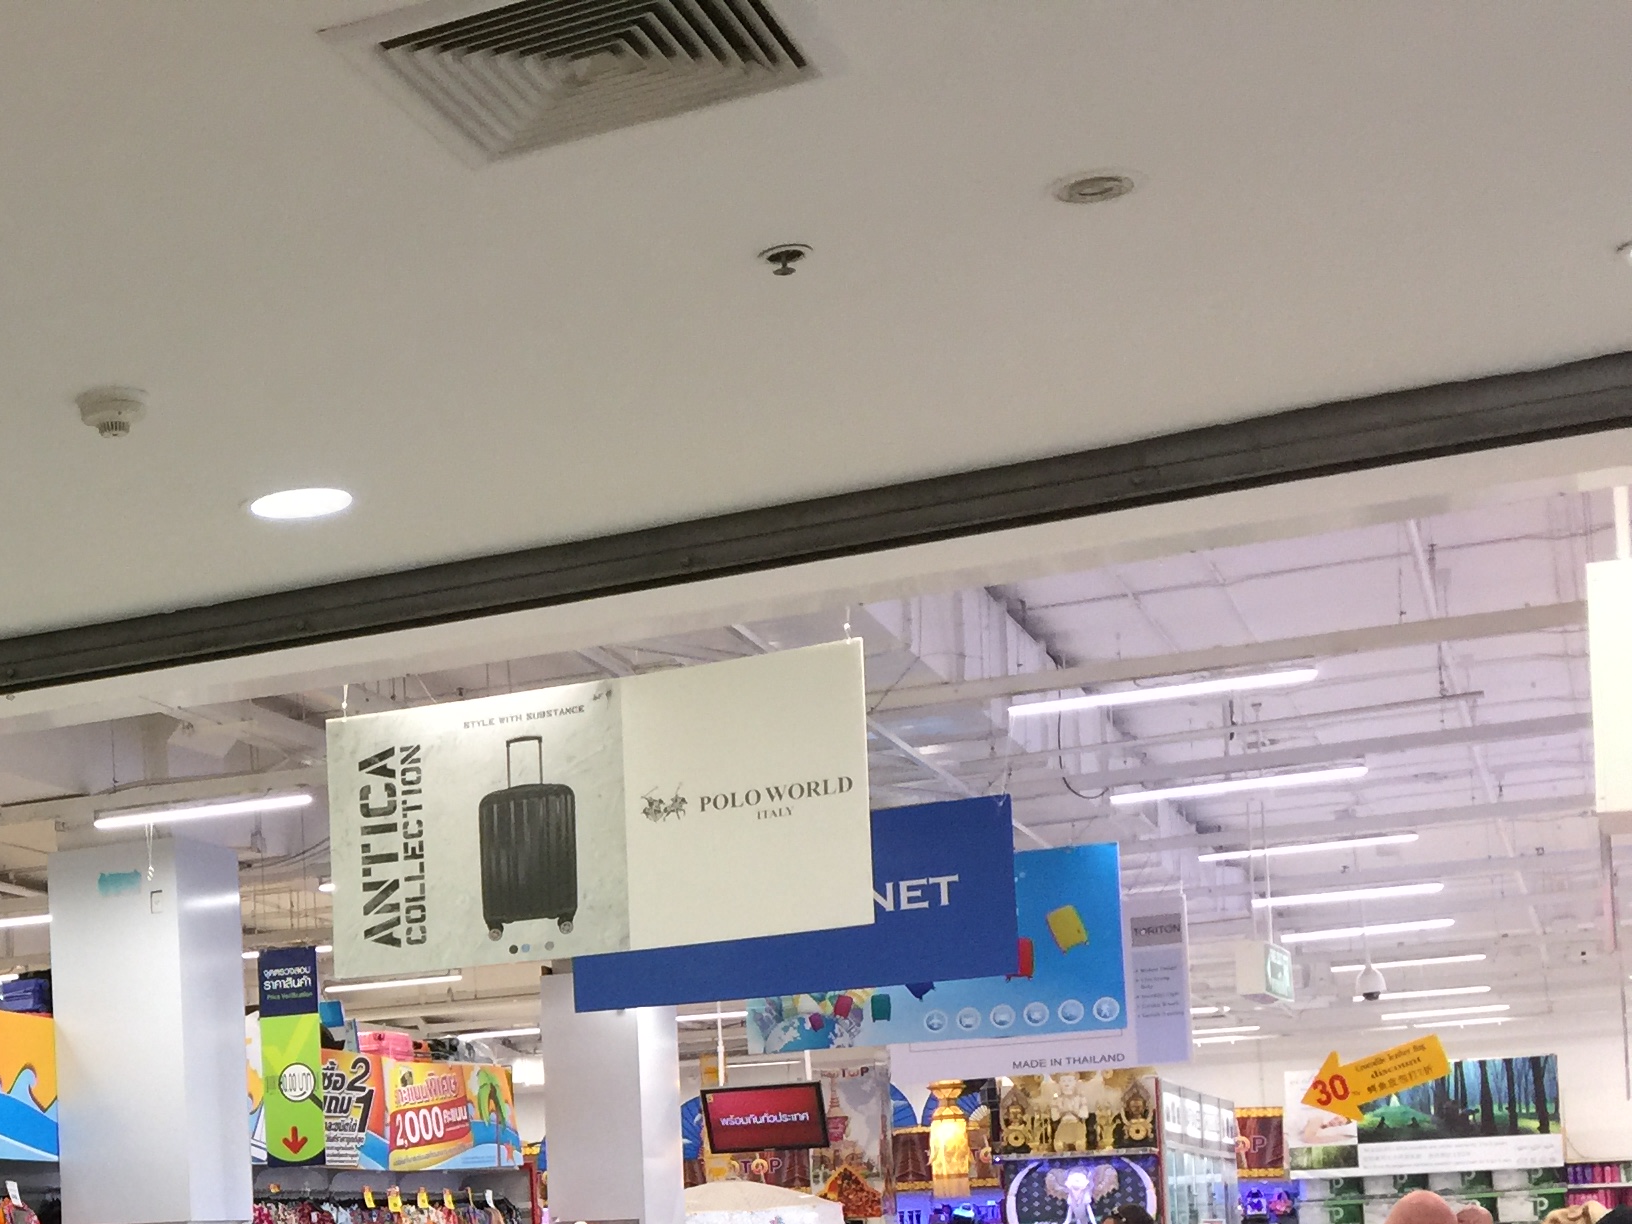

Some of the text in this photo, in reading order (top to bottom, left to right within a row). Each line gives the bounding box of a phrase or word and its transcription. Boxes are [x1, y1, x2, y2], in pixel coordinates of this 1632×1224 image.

[463, 704, 586, 730] STYLE WITH SUBSTANCE
[699, 775, 854, 812] POLO WORLD
[756, 806, 794, 821] ITALY
[358, 746, 402, 948] ANTICA
[400, 744, 427, 946] COLLECTION
[346, 1056, 371, 1092] 2
[1012, 1052, 1126, 1070] MADE IN THAILAND
[1370, 1056, 1422, 1080] discount
[1312, 1073, 1351, 1106] 30
[355, 1088, 374, 1133] 1
[395, 1105, 445, 1148] 2,000
